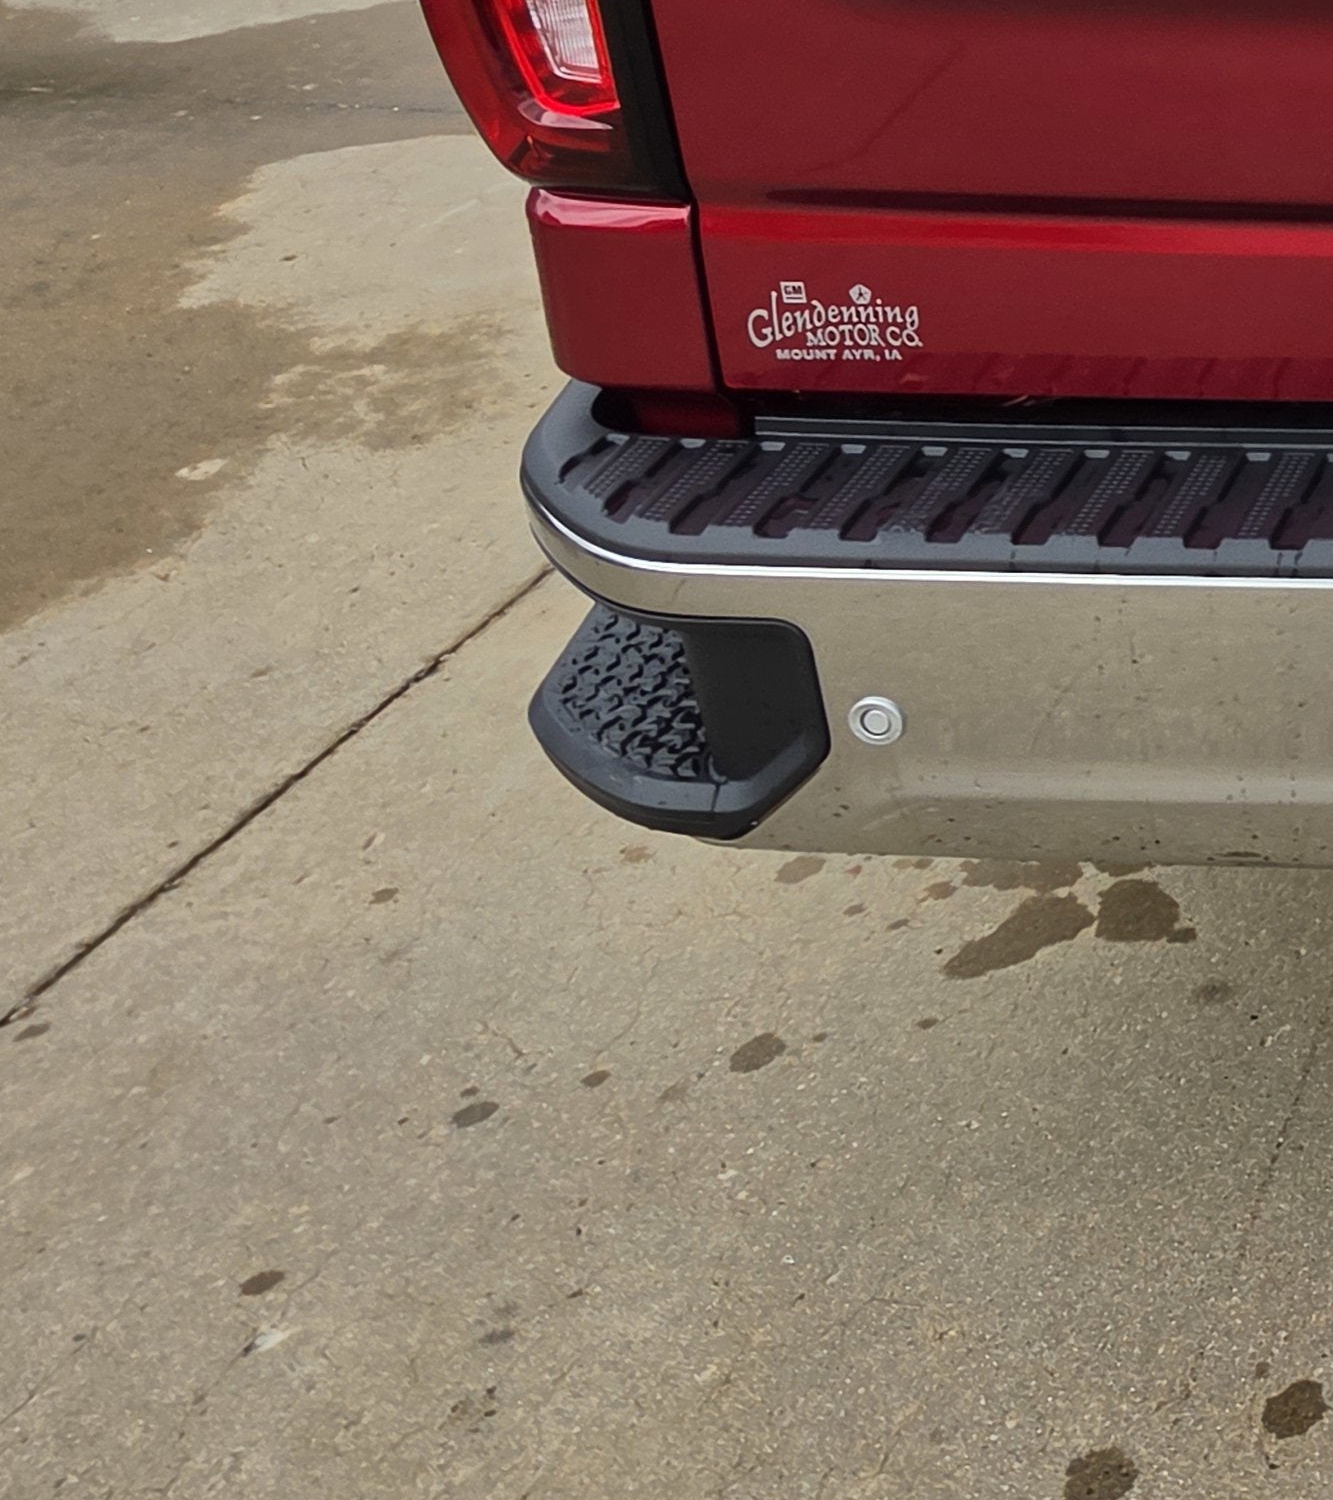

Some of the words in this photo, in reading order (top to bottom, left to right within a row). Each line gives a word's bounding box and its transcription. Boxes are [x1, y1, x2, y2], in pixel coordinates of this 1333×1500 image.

[784, 285, 803, 295] GM
[748, 291, 919, 347] Glendenning
[806, 324, 886, 347] MOTOR
[776, 349, 837, 360] MOUNT
[842, 349, 880, 362] AYR,
[885, 349, 903, 360] IA
